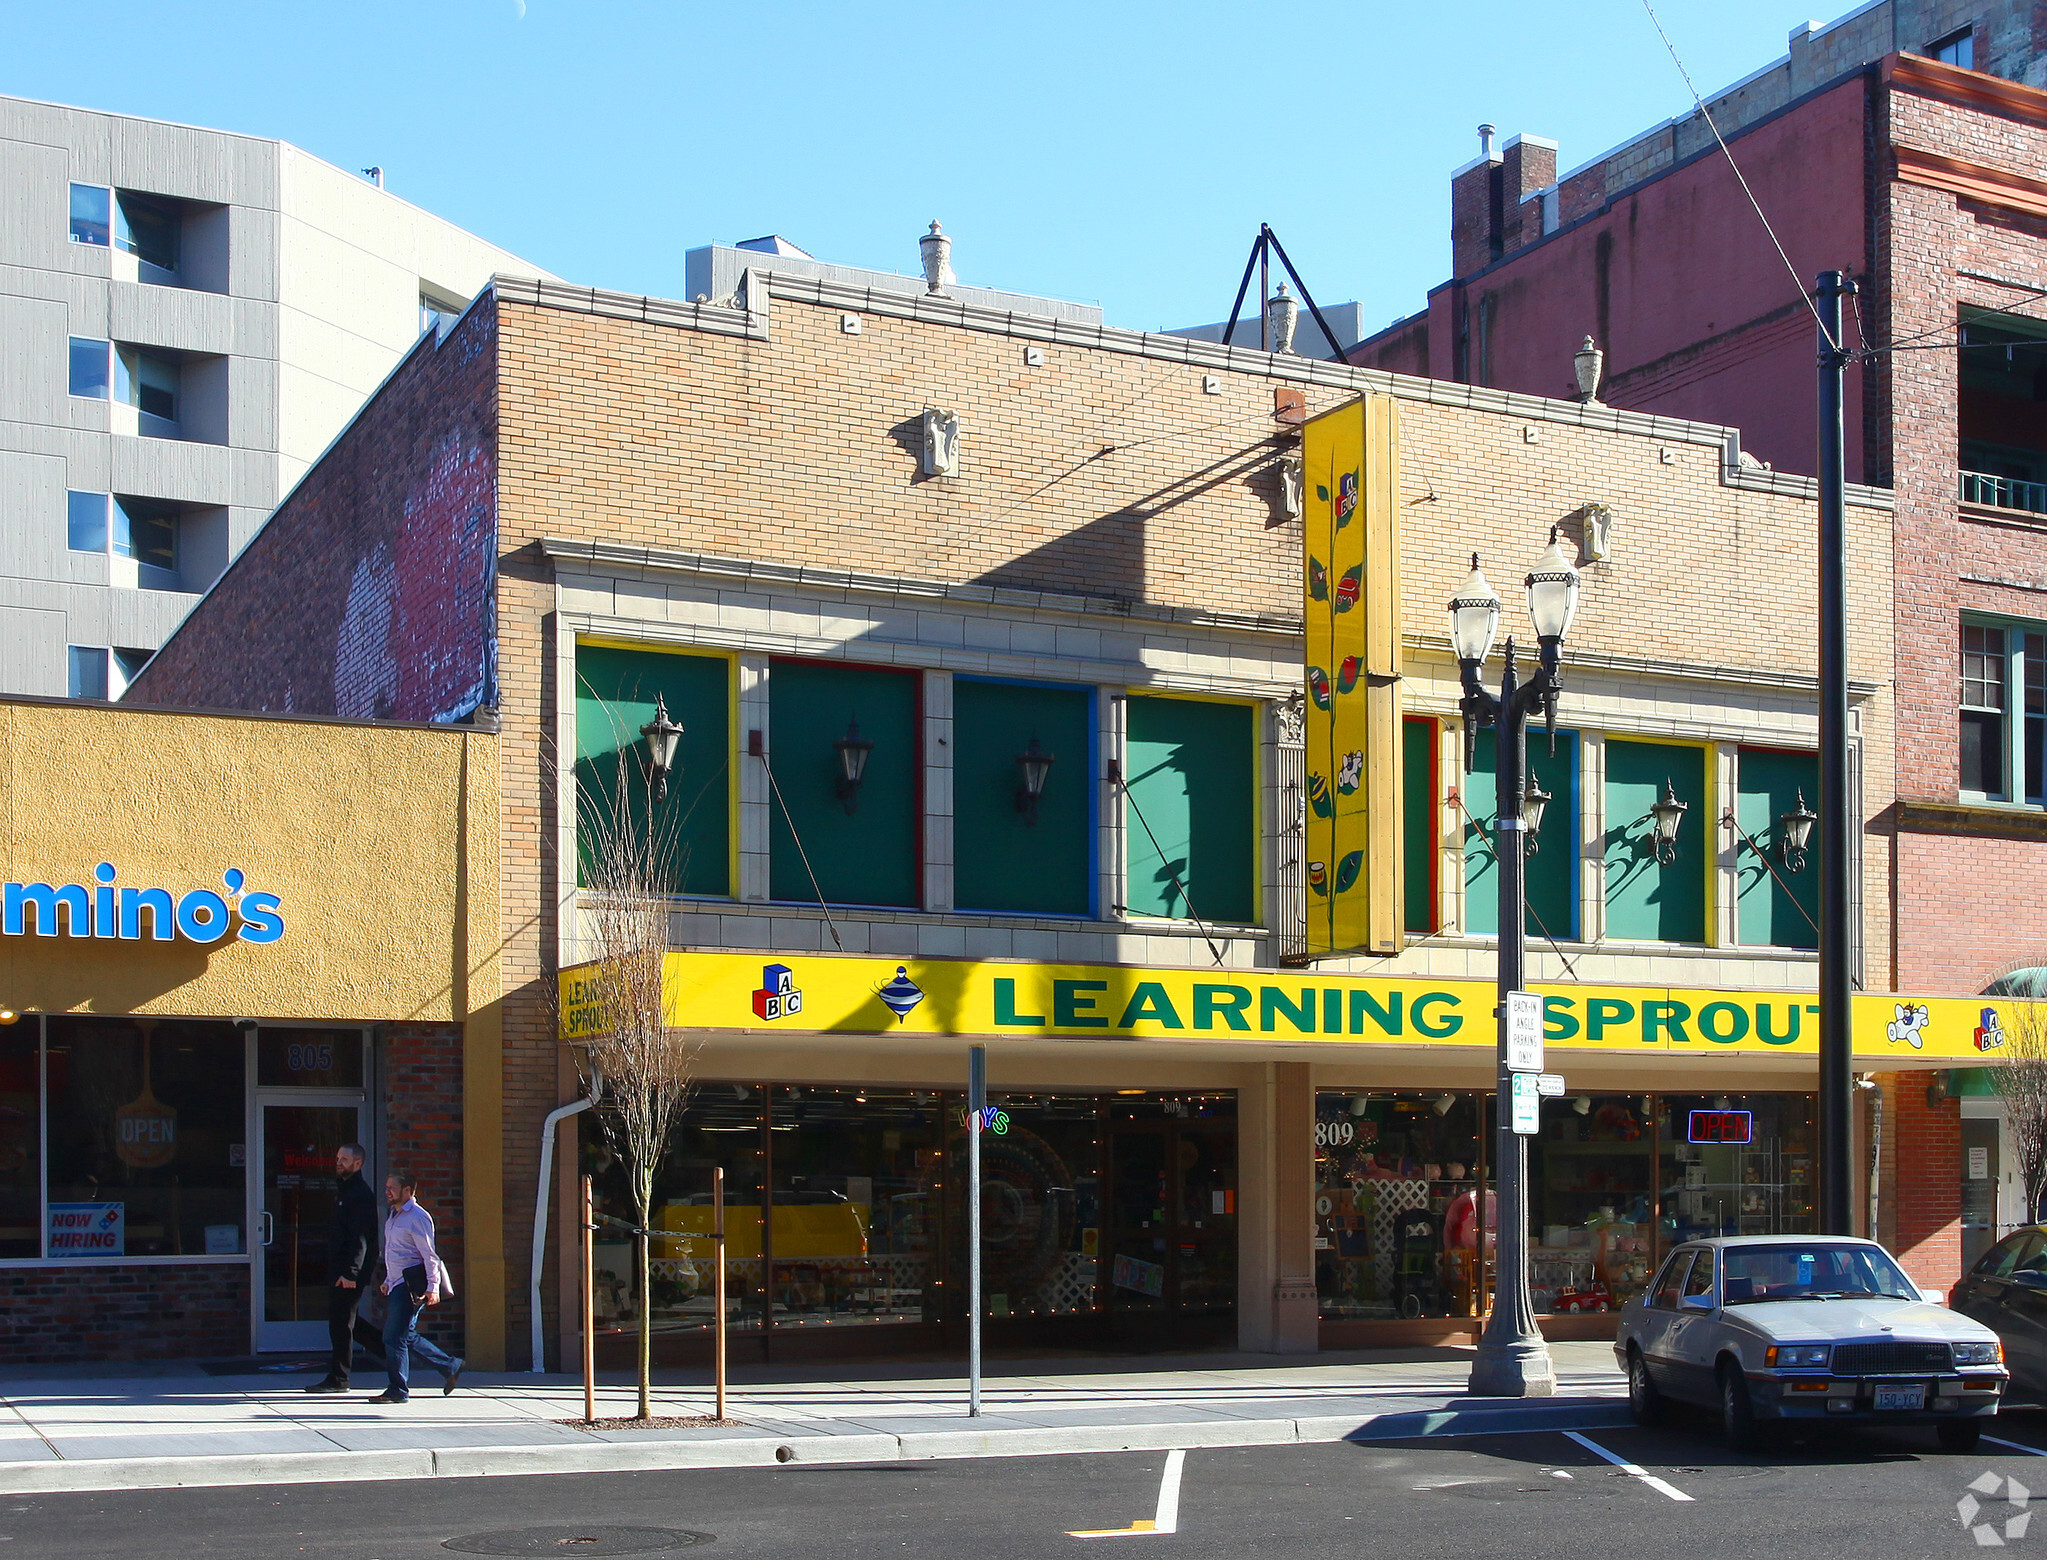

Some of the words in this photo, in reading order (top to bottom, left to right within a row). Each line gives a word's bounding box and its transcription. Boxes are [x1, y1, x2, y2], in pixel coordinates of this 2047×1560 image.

[993, 977, 1464, 1039] LEARNING
[1513, 999, 1537, 1013] BACK-IN
[1516, 1017, 1534, 1030] ANGLE
[1513, 1033, 1538, 1047] PARKING
[288, 1043, 332, 1070] 805
[1518, 1051, 1533, 1064] ONLY
[1163, 1101, 1181, 1114] 809
[121, 1118, 175, 1143] OPEN
[1314, 1122, 1354, 1146] 809
[1691, 1113, 1748, 1140] OPEN
[51, 1213, 92, 1228] NOW
[50, 1232, 116, 1249] HIRING
